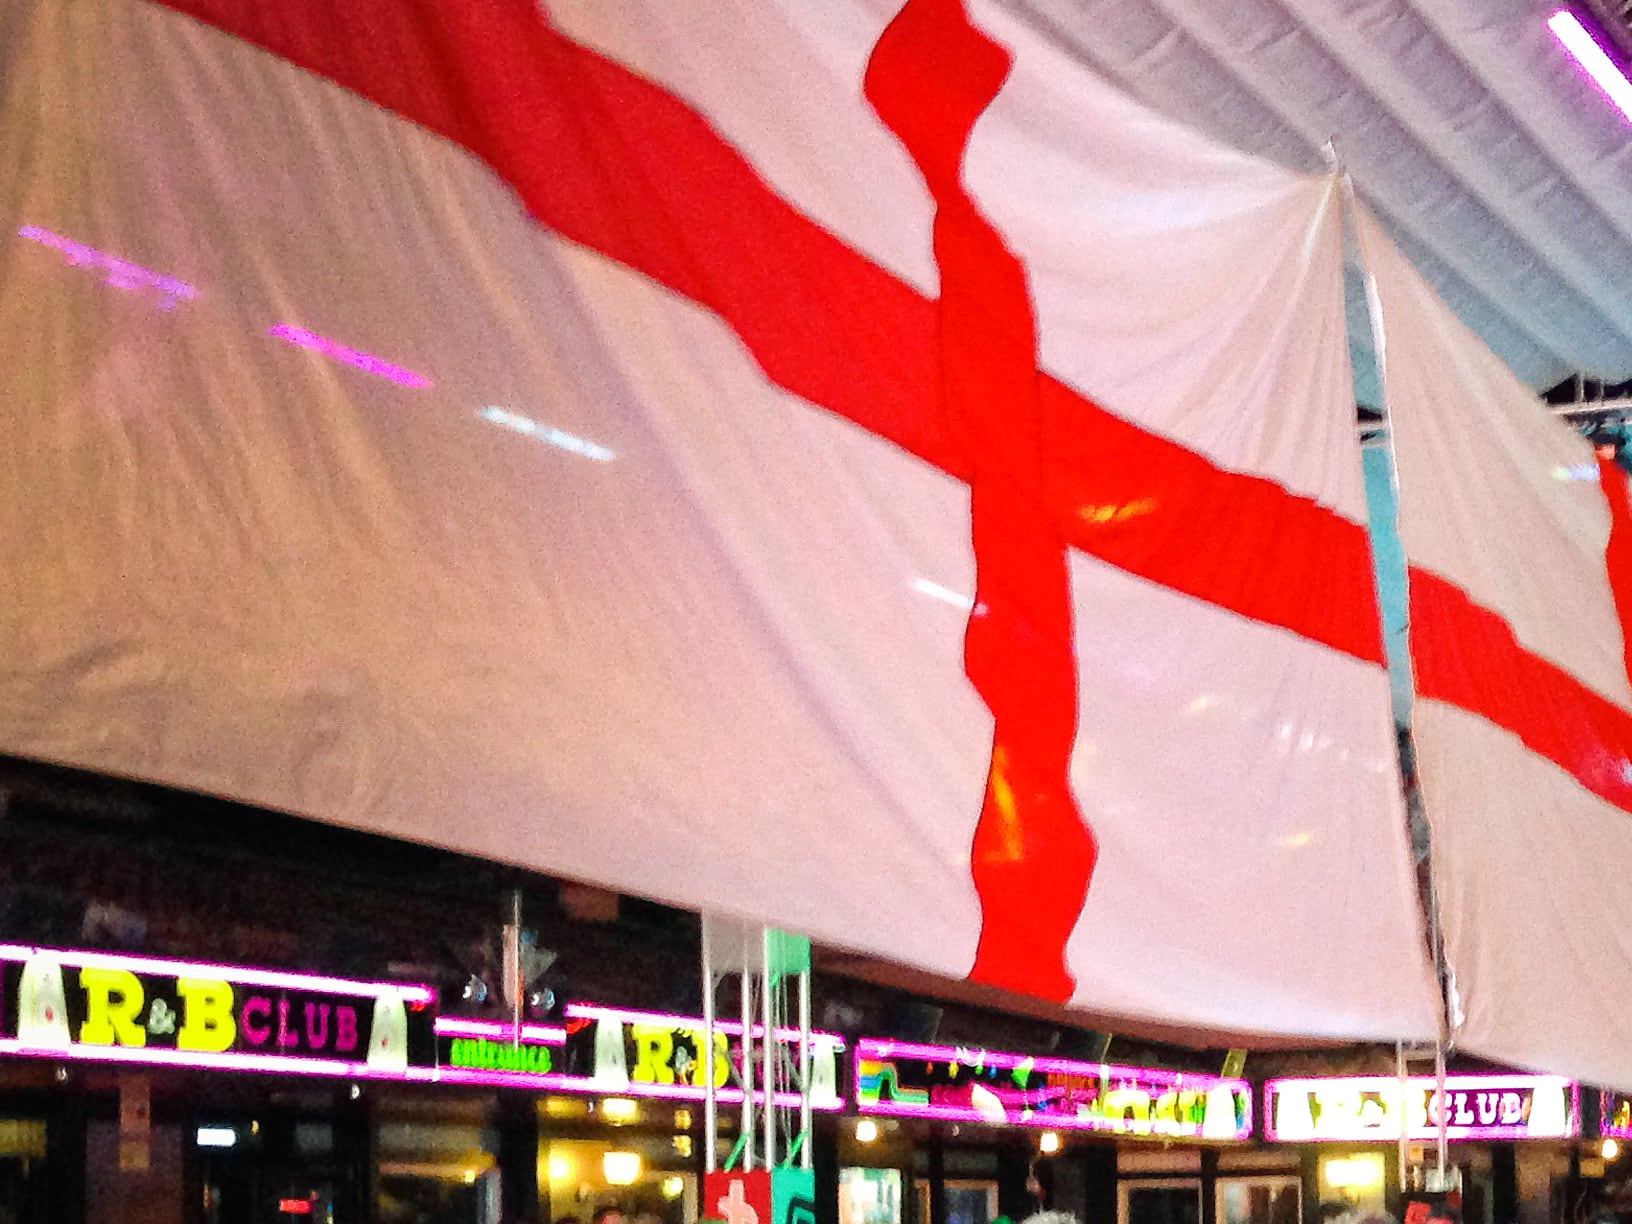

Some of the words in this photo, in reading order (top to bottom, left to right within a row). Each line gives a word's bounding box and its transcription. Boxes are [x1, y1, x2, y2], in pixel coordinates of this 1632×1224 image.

[79, 967, 236, 1052] R&B
[240, 996, 358, 1052] CLUB
[1428, 1090, 1523, 1126] CLUB
